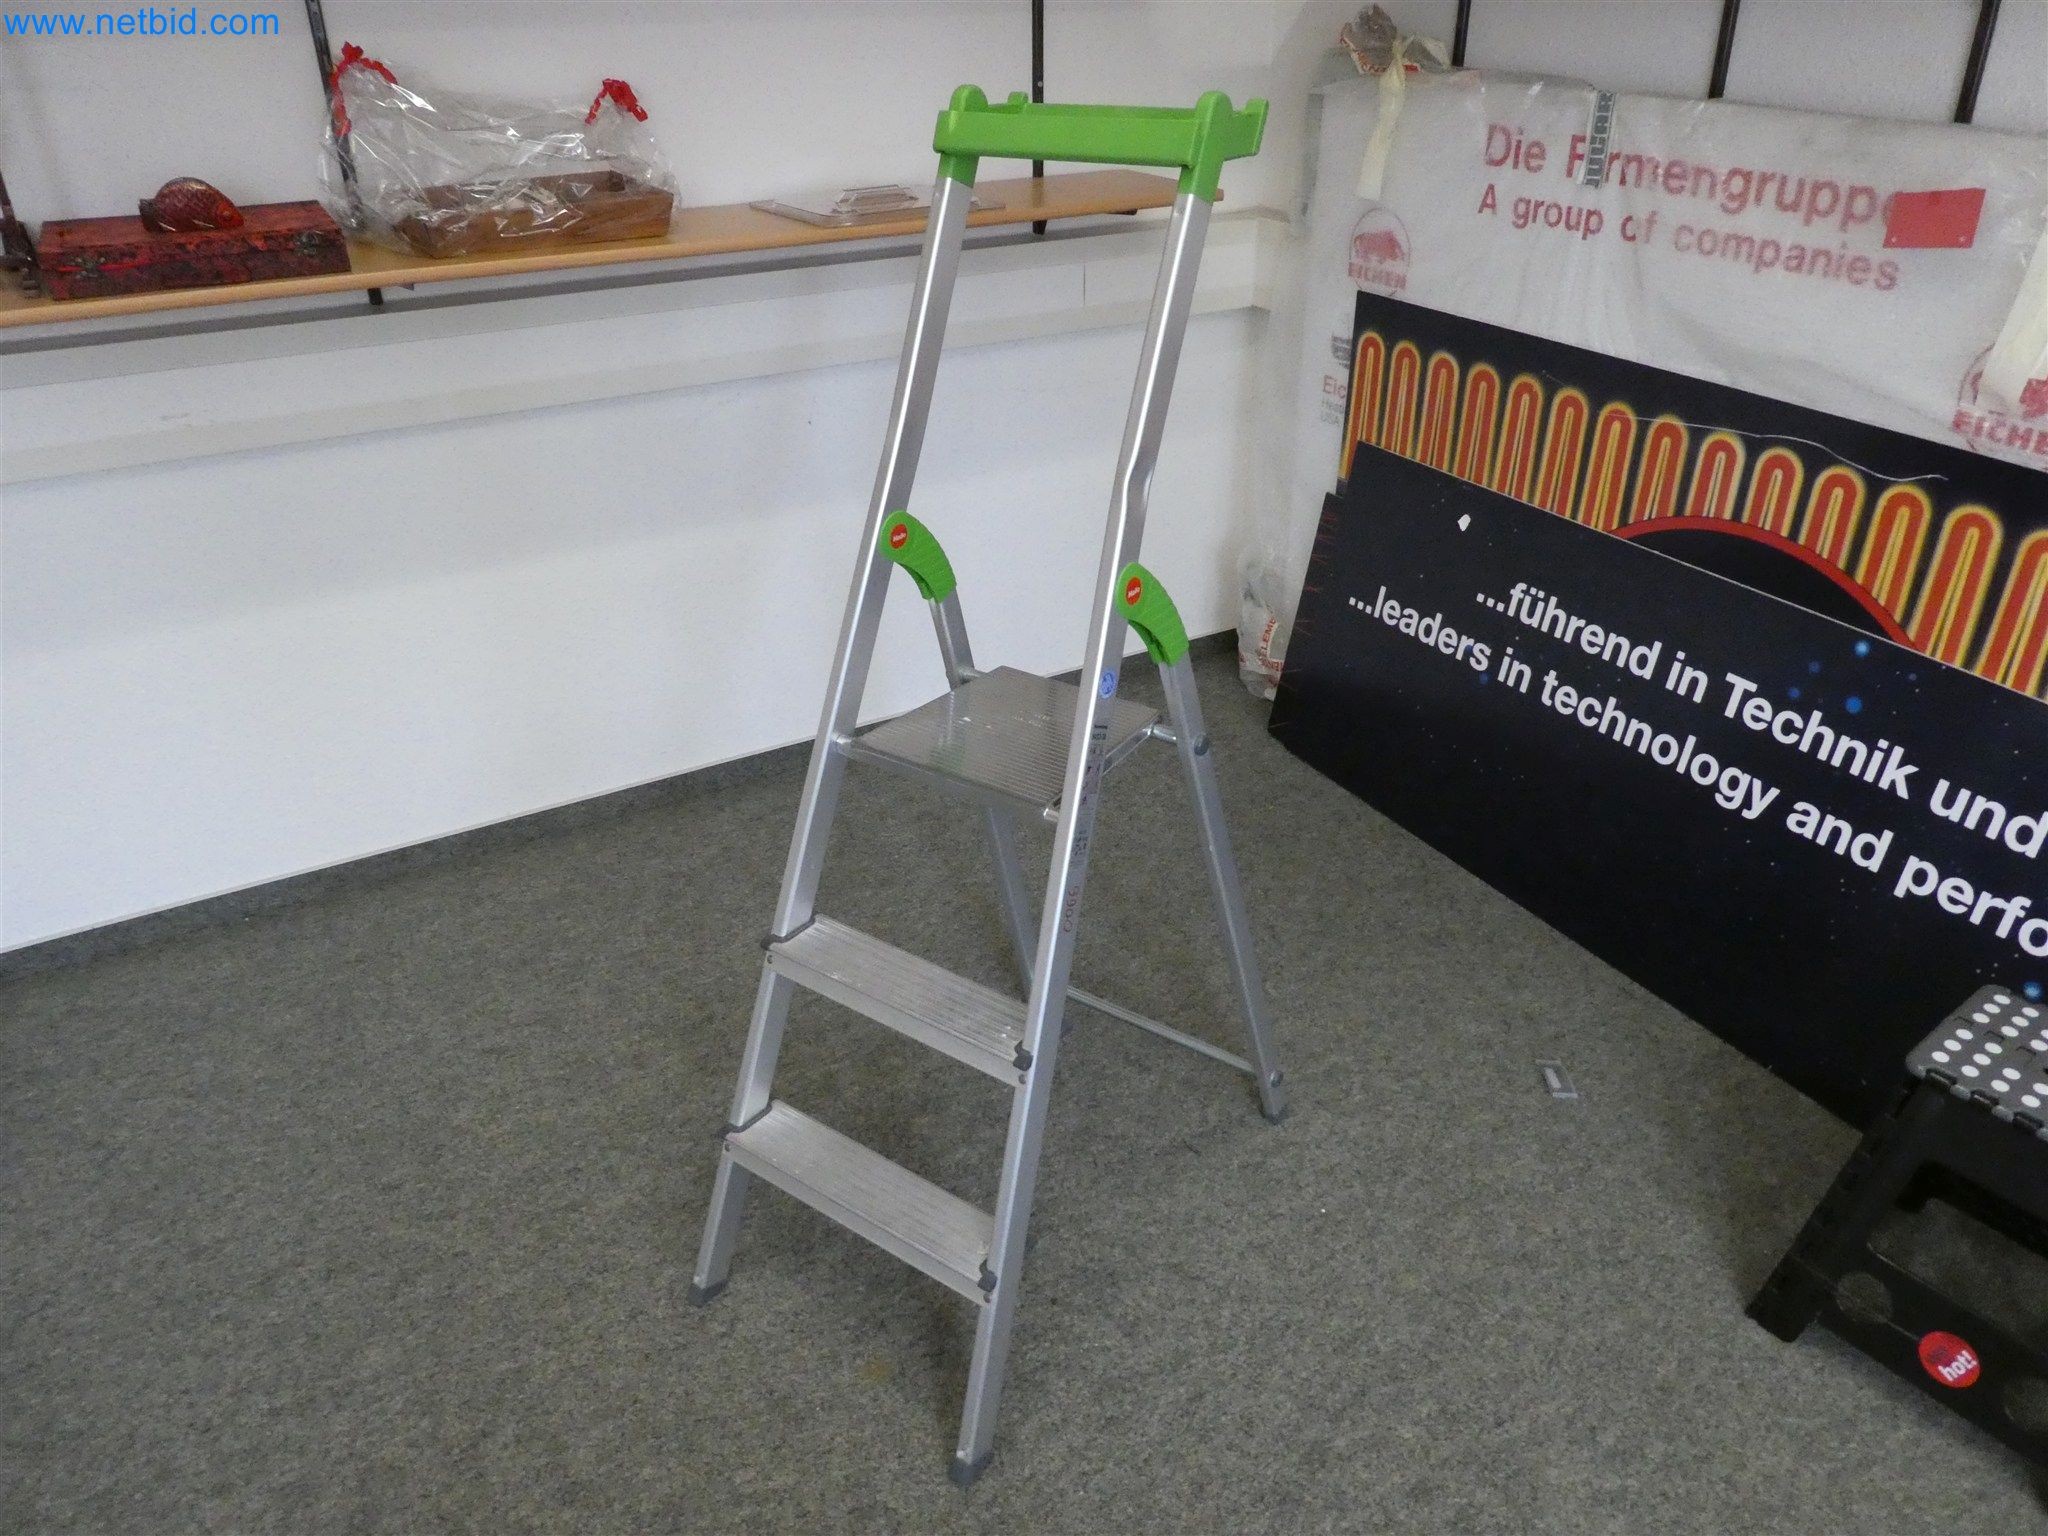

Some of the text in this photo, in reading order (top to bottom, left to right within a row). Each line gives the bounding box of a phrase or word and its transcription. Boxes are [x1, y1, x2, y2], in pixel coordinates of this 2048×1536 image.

[1485, 123, 1547, 173] Die
[1566, 133, 1893, 234] Frmengrupp
[1478, 183, 1497, 214] A
[1512, 197, 1604, 241] group
[1673, 224, 1900, 291] companies
[1348, 586, 1492, 671] ...leaders
[1498, 647, 1532, 693] in
[1541, 669, 1781, 819] technology
[1786, 799, 1894, 872] and
[1476, 583, 2048, 859] ...führend in Technik und
[1938, 1350, 1977, 1381] hot!
